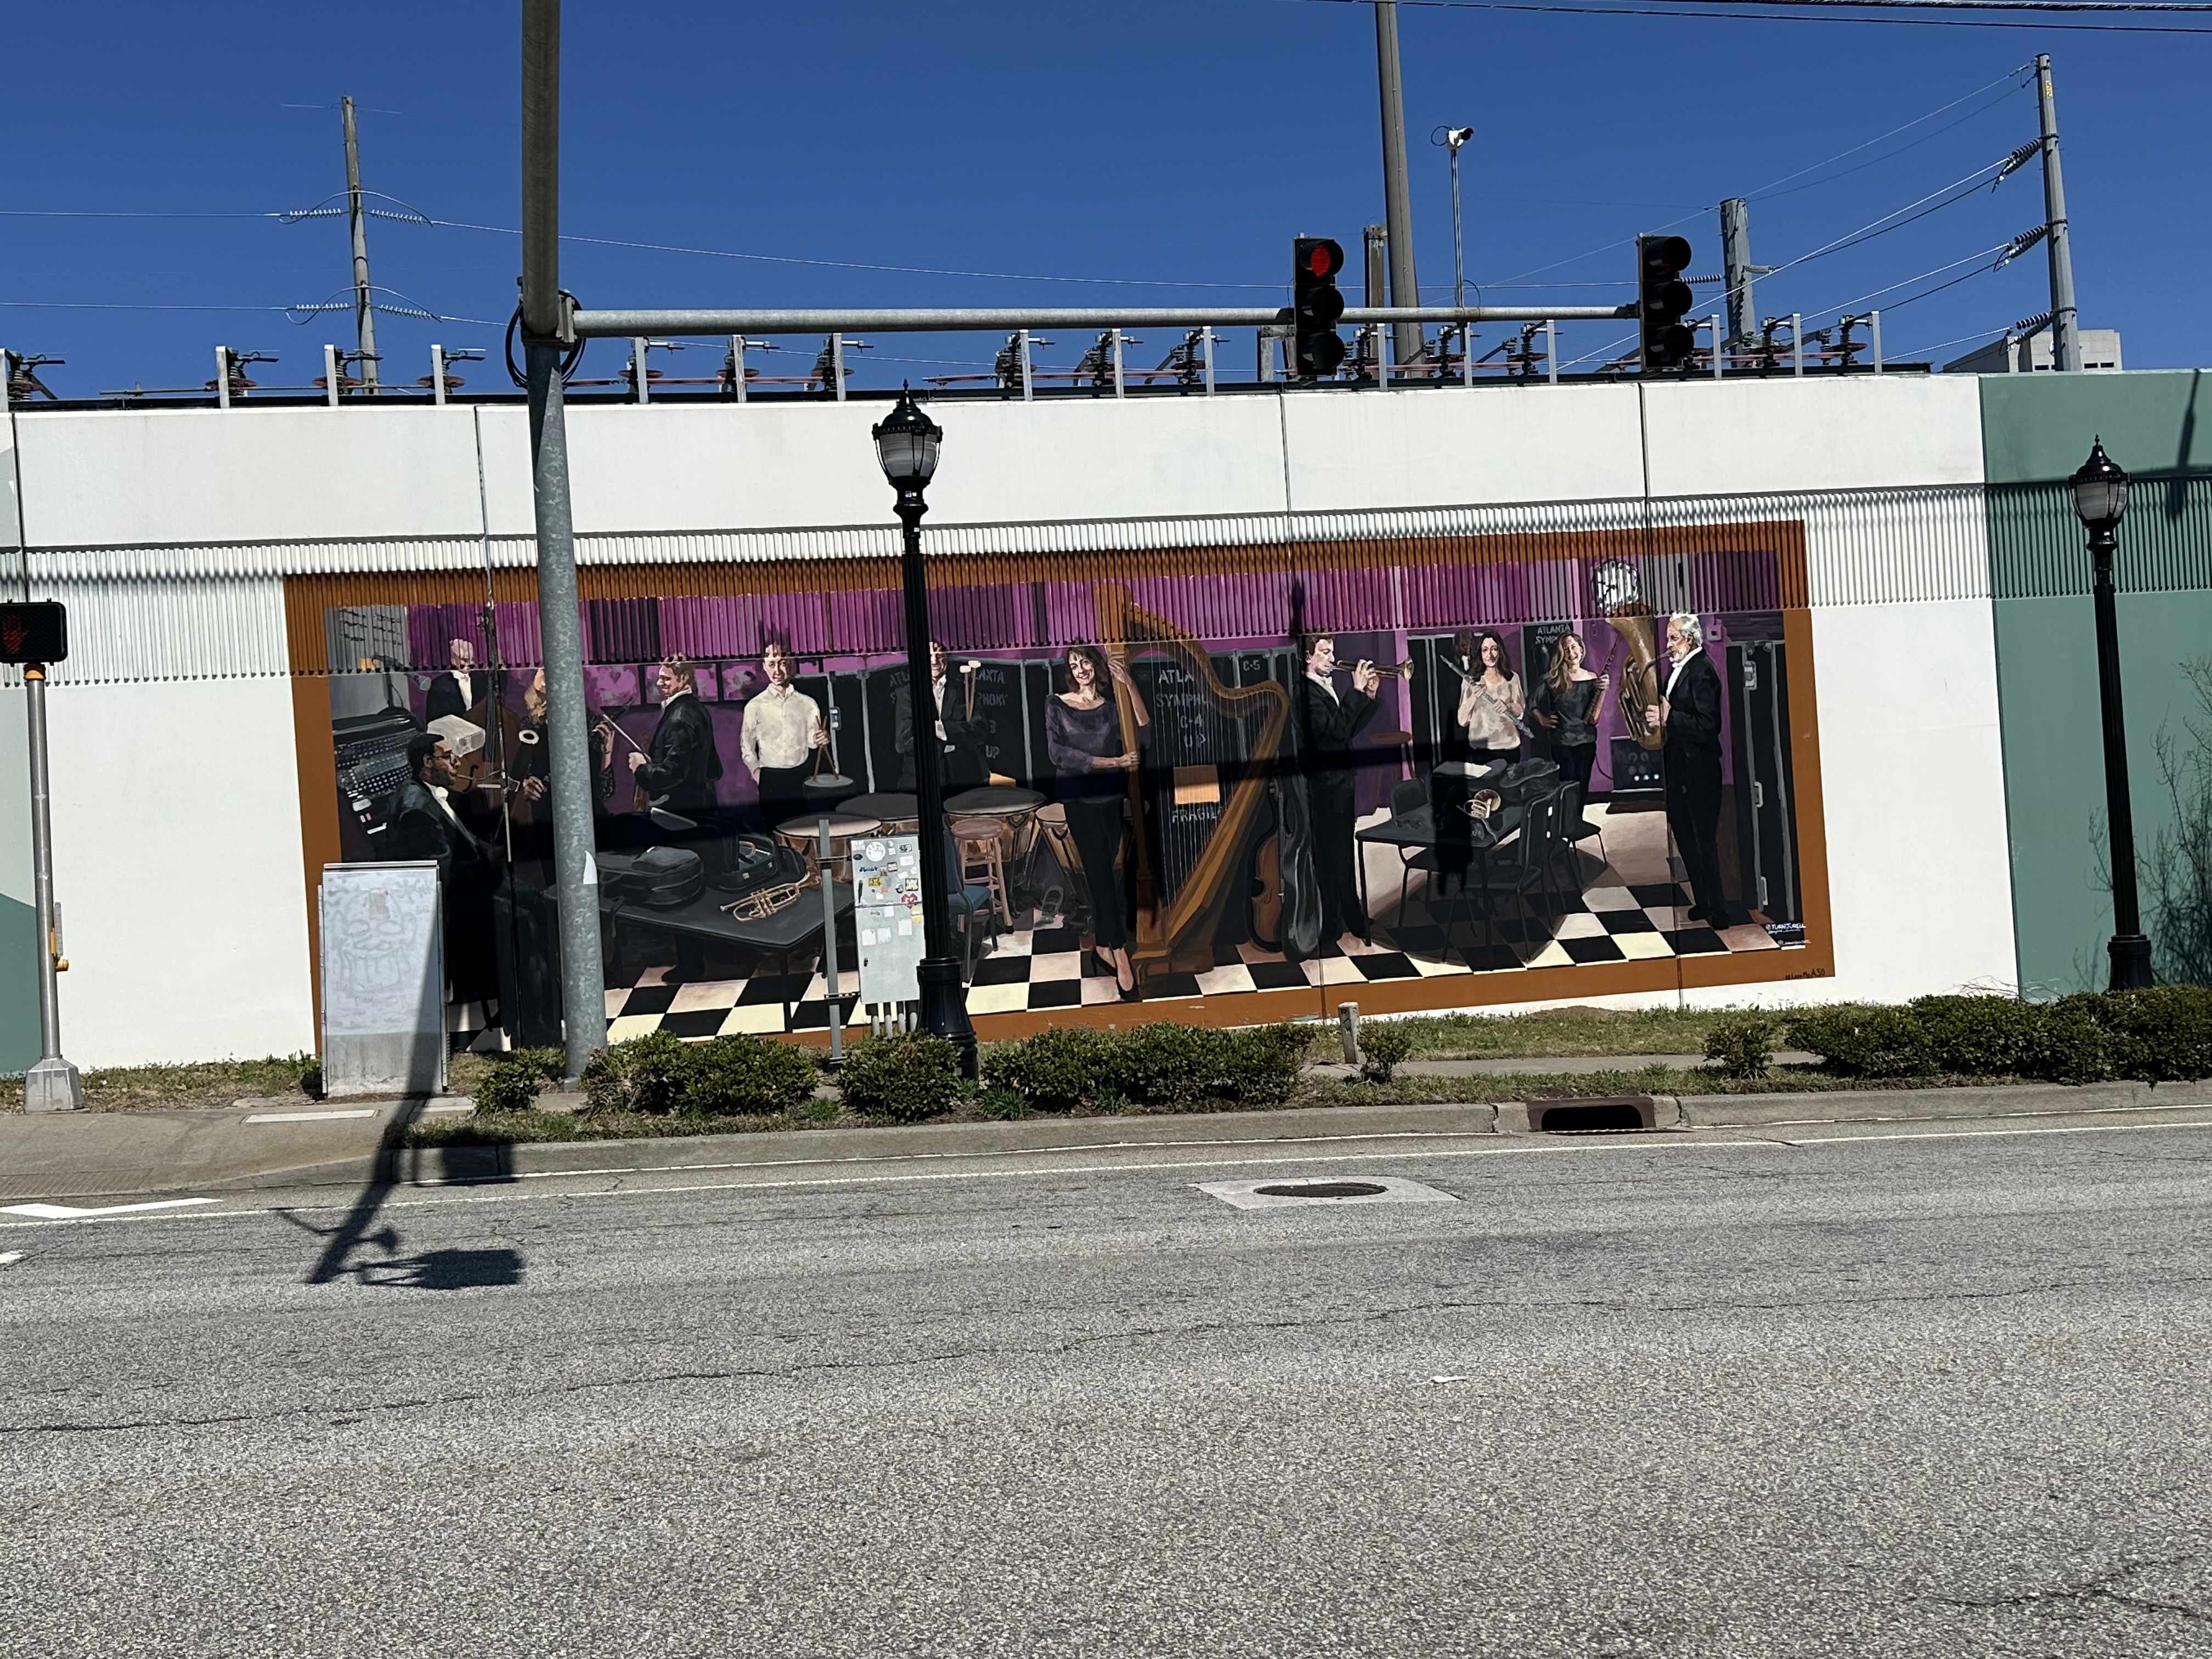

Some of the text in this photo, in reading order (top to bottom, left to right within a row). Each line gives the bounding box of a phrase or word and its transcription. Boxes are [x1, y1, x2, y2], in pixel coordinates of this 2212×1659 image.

[1537, 623, 1571, 635] ATLANTA
[1159, 669, 1194, 684] ATLA
[1183, 733, 1206, 748] UP
[985, 744, 1000, 759] UP
[1811, 968, 1825, 977] ASO
